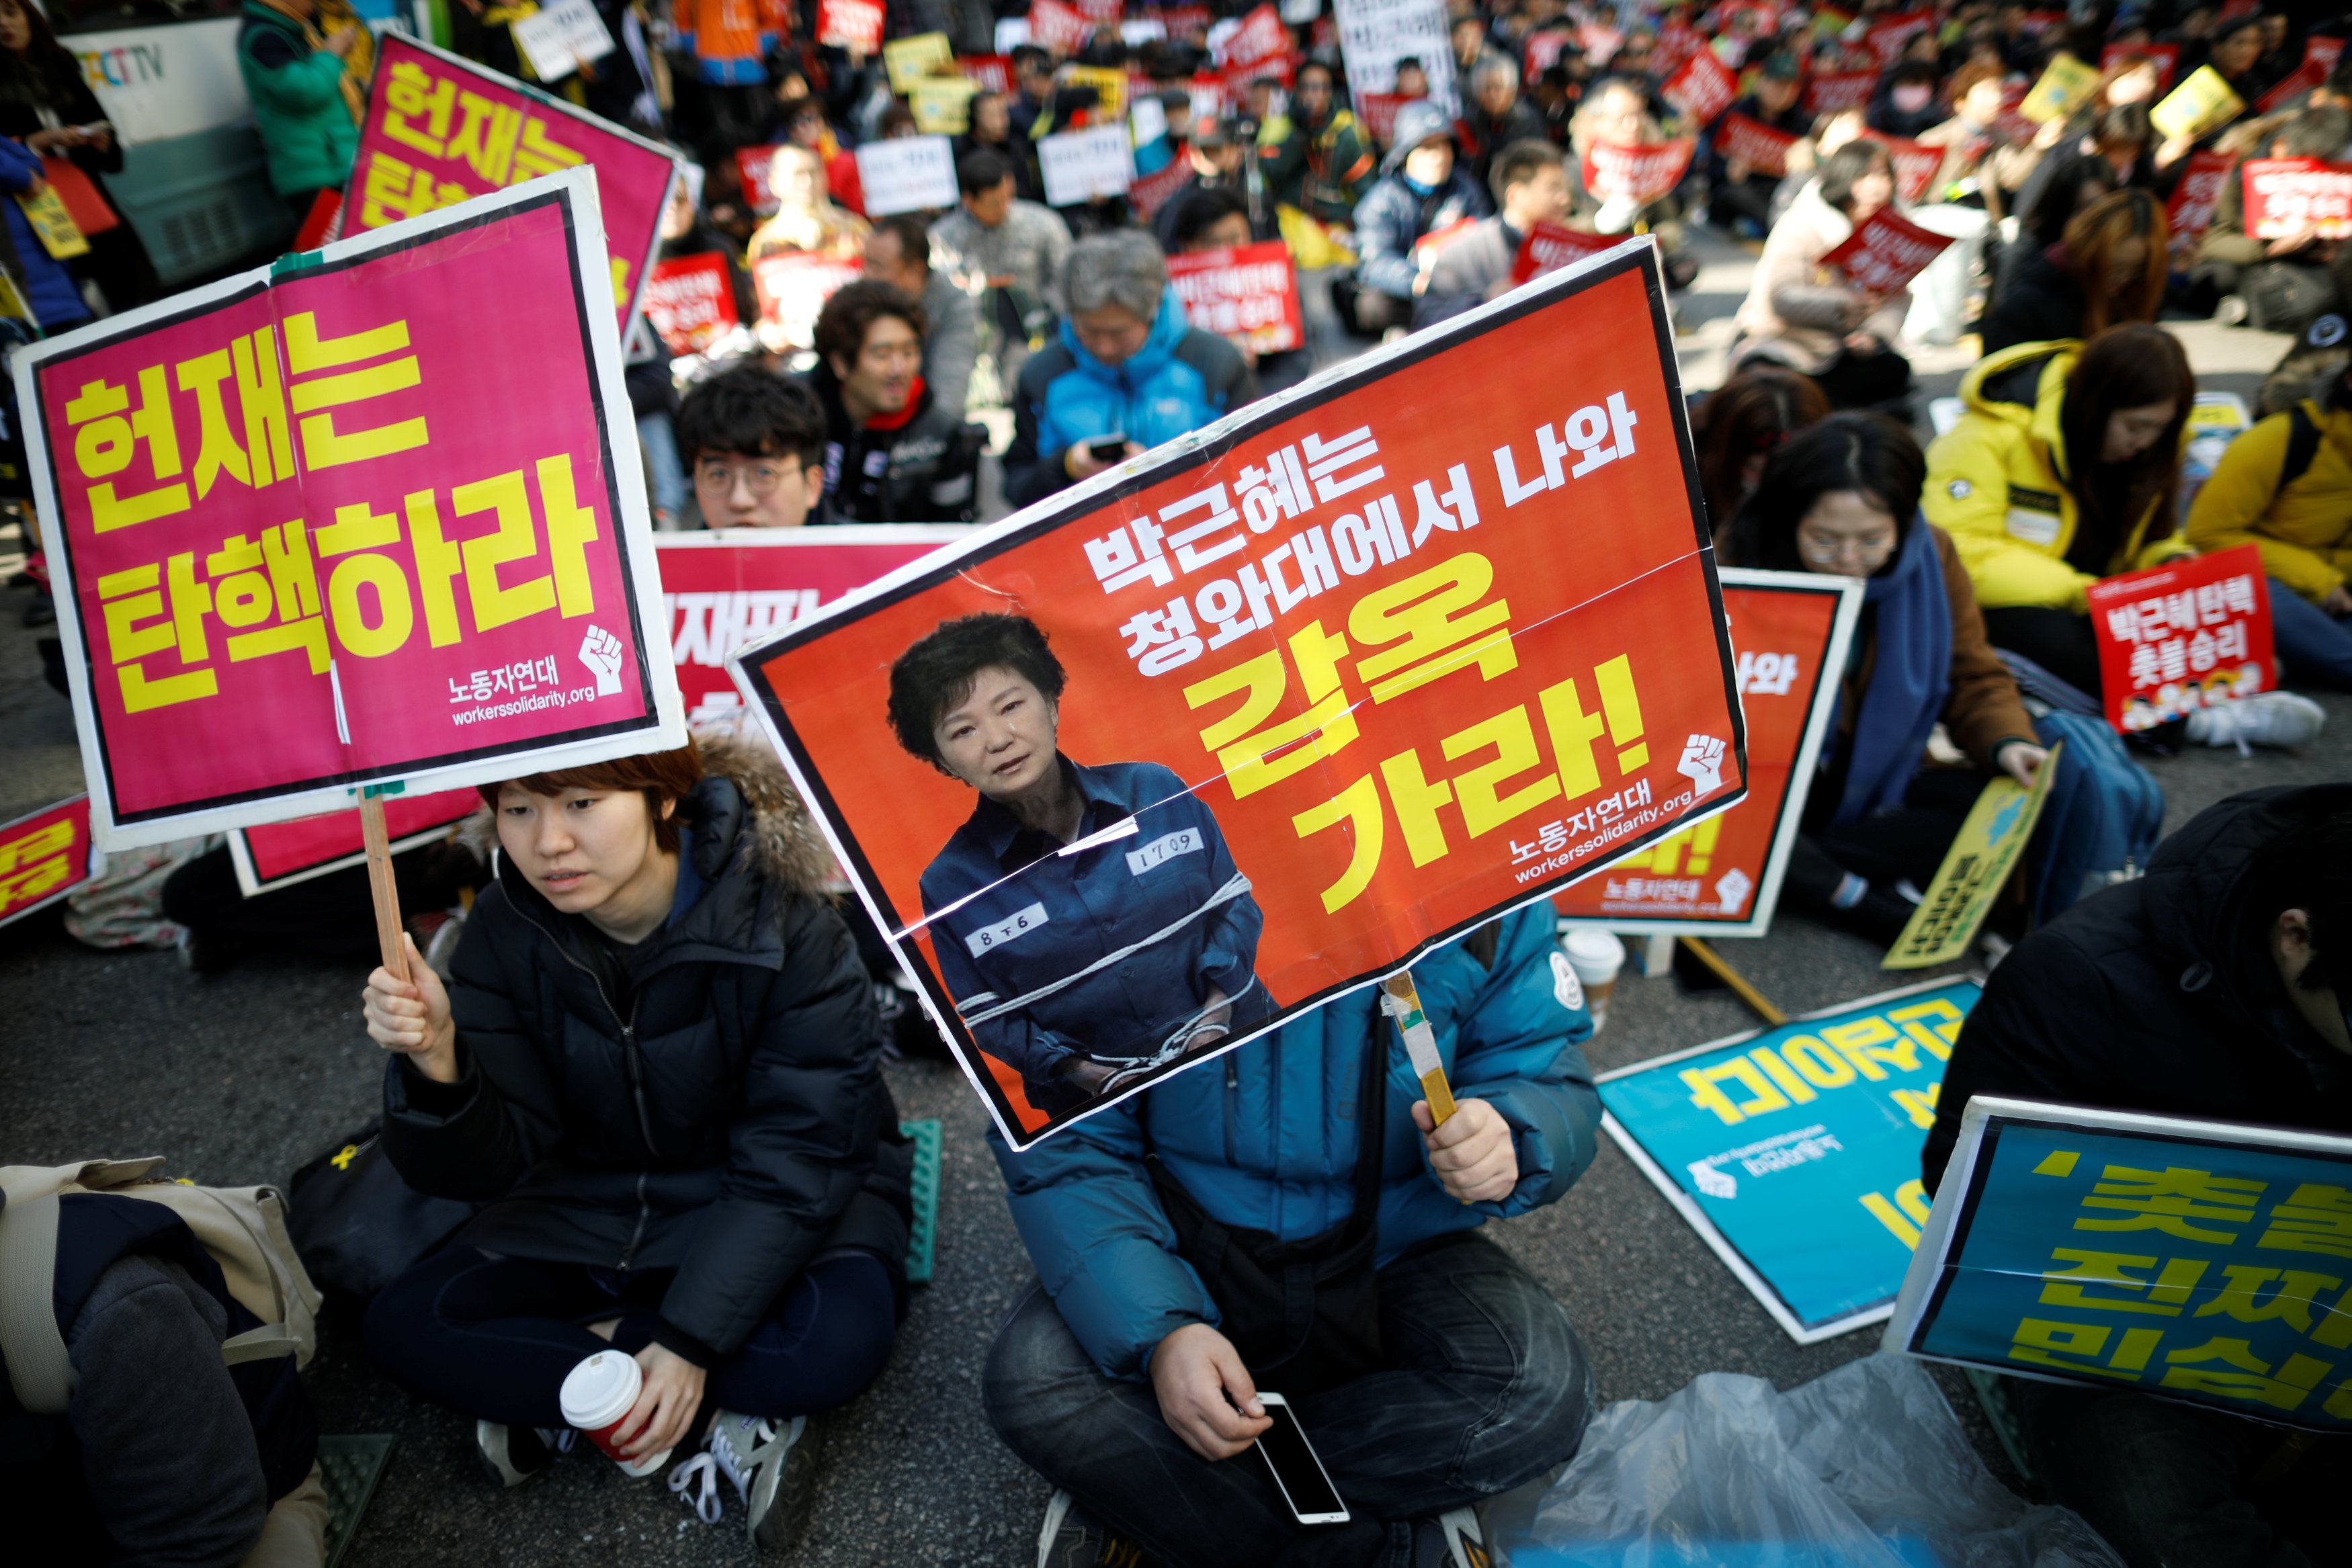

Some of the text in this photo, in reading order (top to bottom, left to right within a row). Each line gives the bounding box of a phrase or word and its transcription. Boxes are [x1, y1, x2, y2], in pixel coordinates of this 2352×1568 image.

[66, 310, 429, 534] 헌재는
[97, 453, 597, 713] 탄핵하라
[1083, 425, 1386, 594] 박근혜는
[1119, 391, 1638, 677] 청와대에서 나와
[448, 654, 559, 704] 노동자연대
[452, 686, 596, 726] workerssolidarity.org
[1182, 552, 1519, 800] 감옥
[1140, 834, 1191, 867] 1709
[1292, 653, 1650, 914] 가라!
[1509, 777, 1652, 865] 노동자연대
[1515, 790, 1693, 884] workerssolidarity.org
